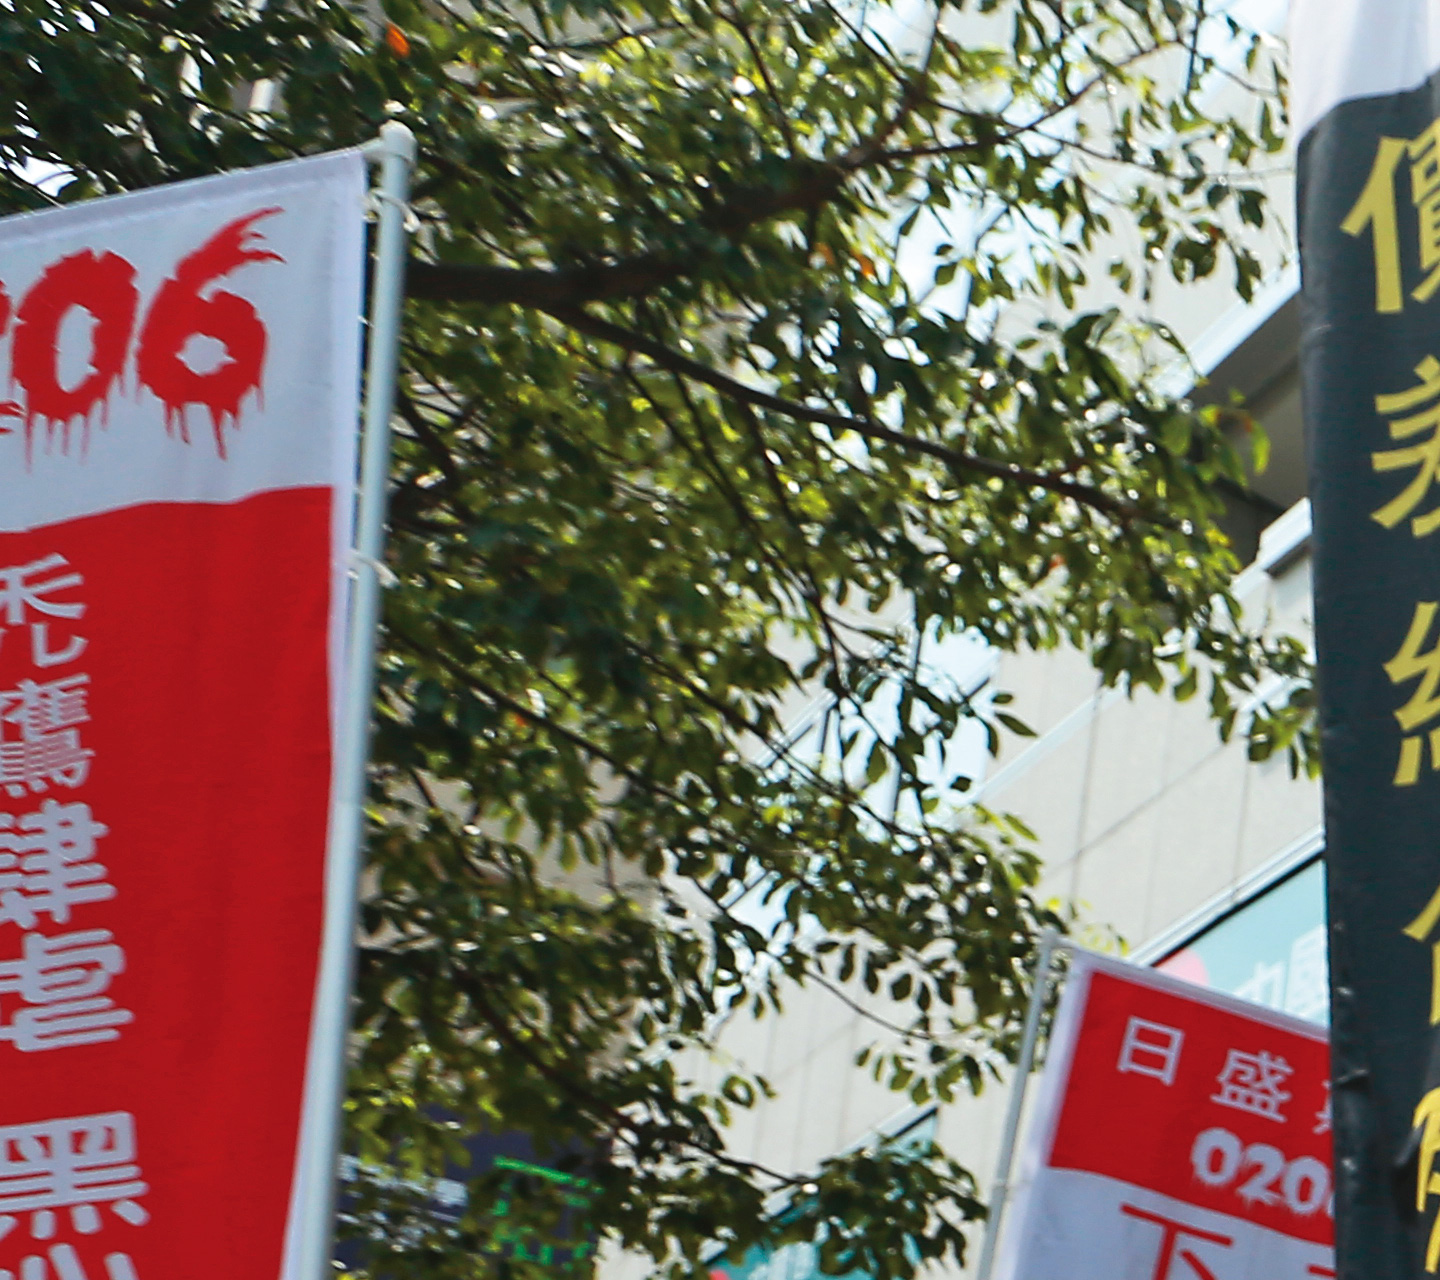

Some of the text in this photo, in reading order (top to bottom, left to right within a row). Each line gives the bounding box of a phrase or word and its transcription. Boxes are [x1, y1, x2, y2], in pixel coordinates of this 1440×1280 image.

[0, 207, 284, 471] 06
[1116, 1016, 1332, 1133] 日盛
[1190, 1127, 1335, 1218] 020
